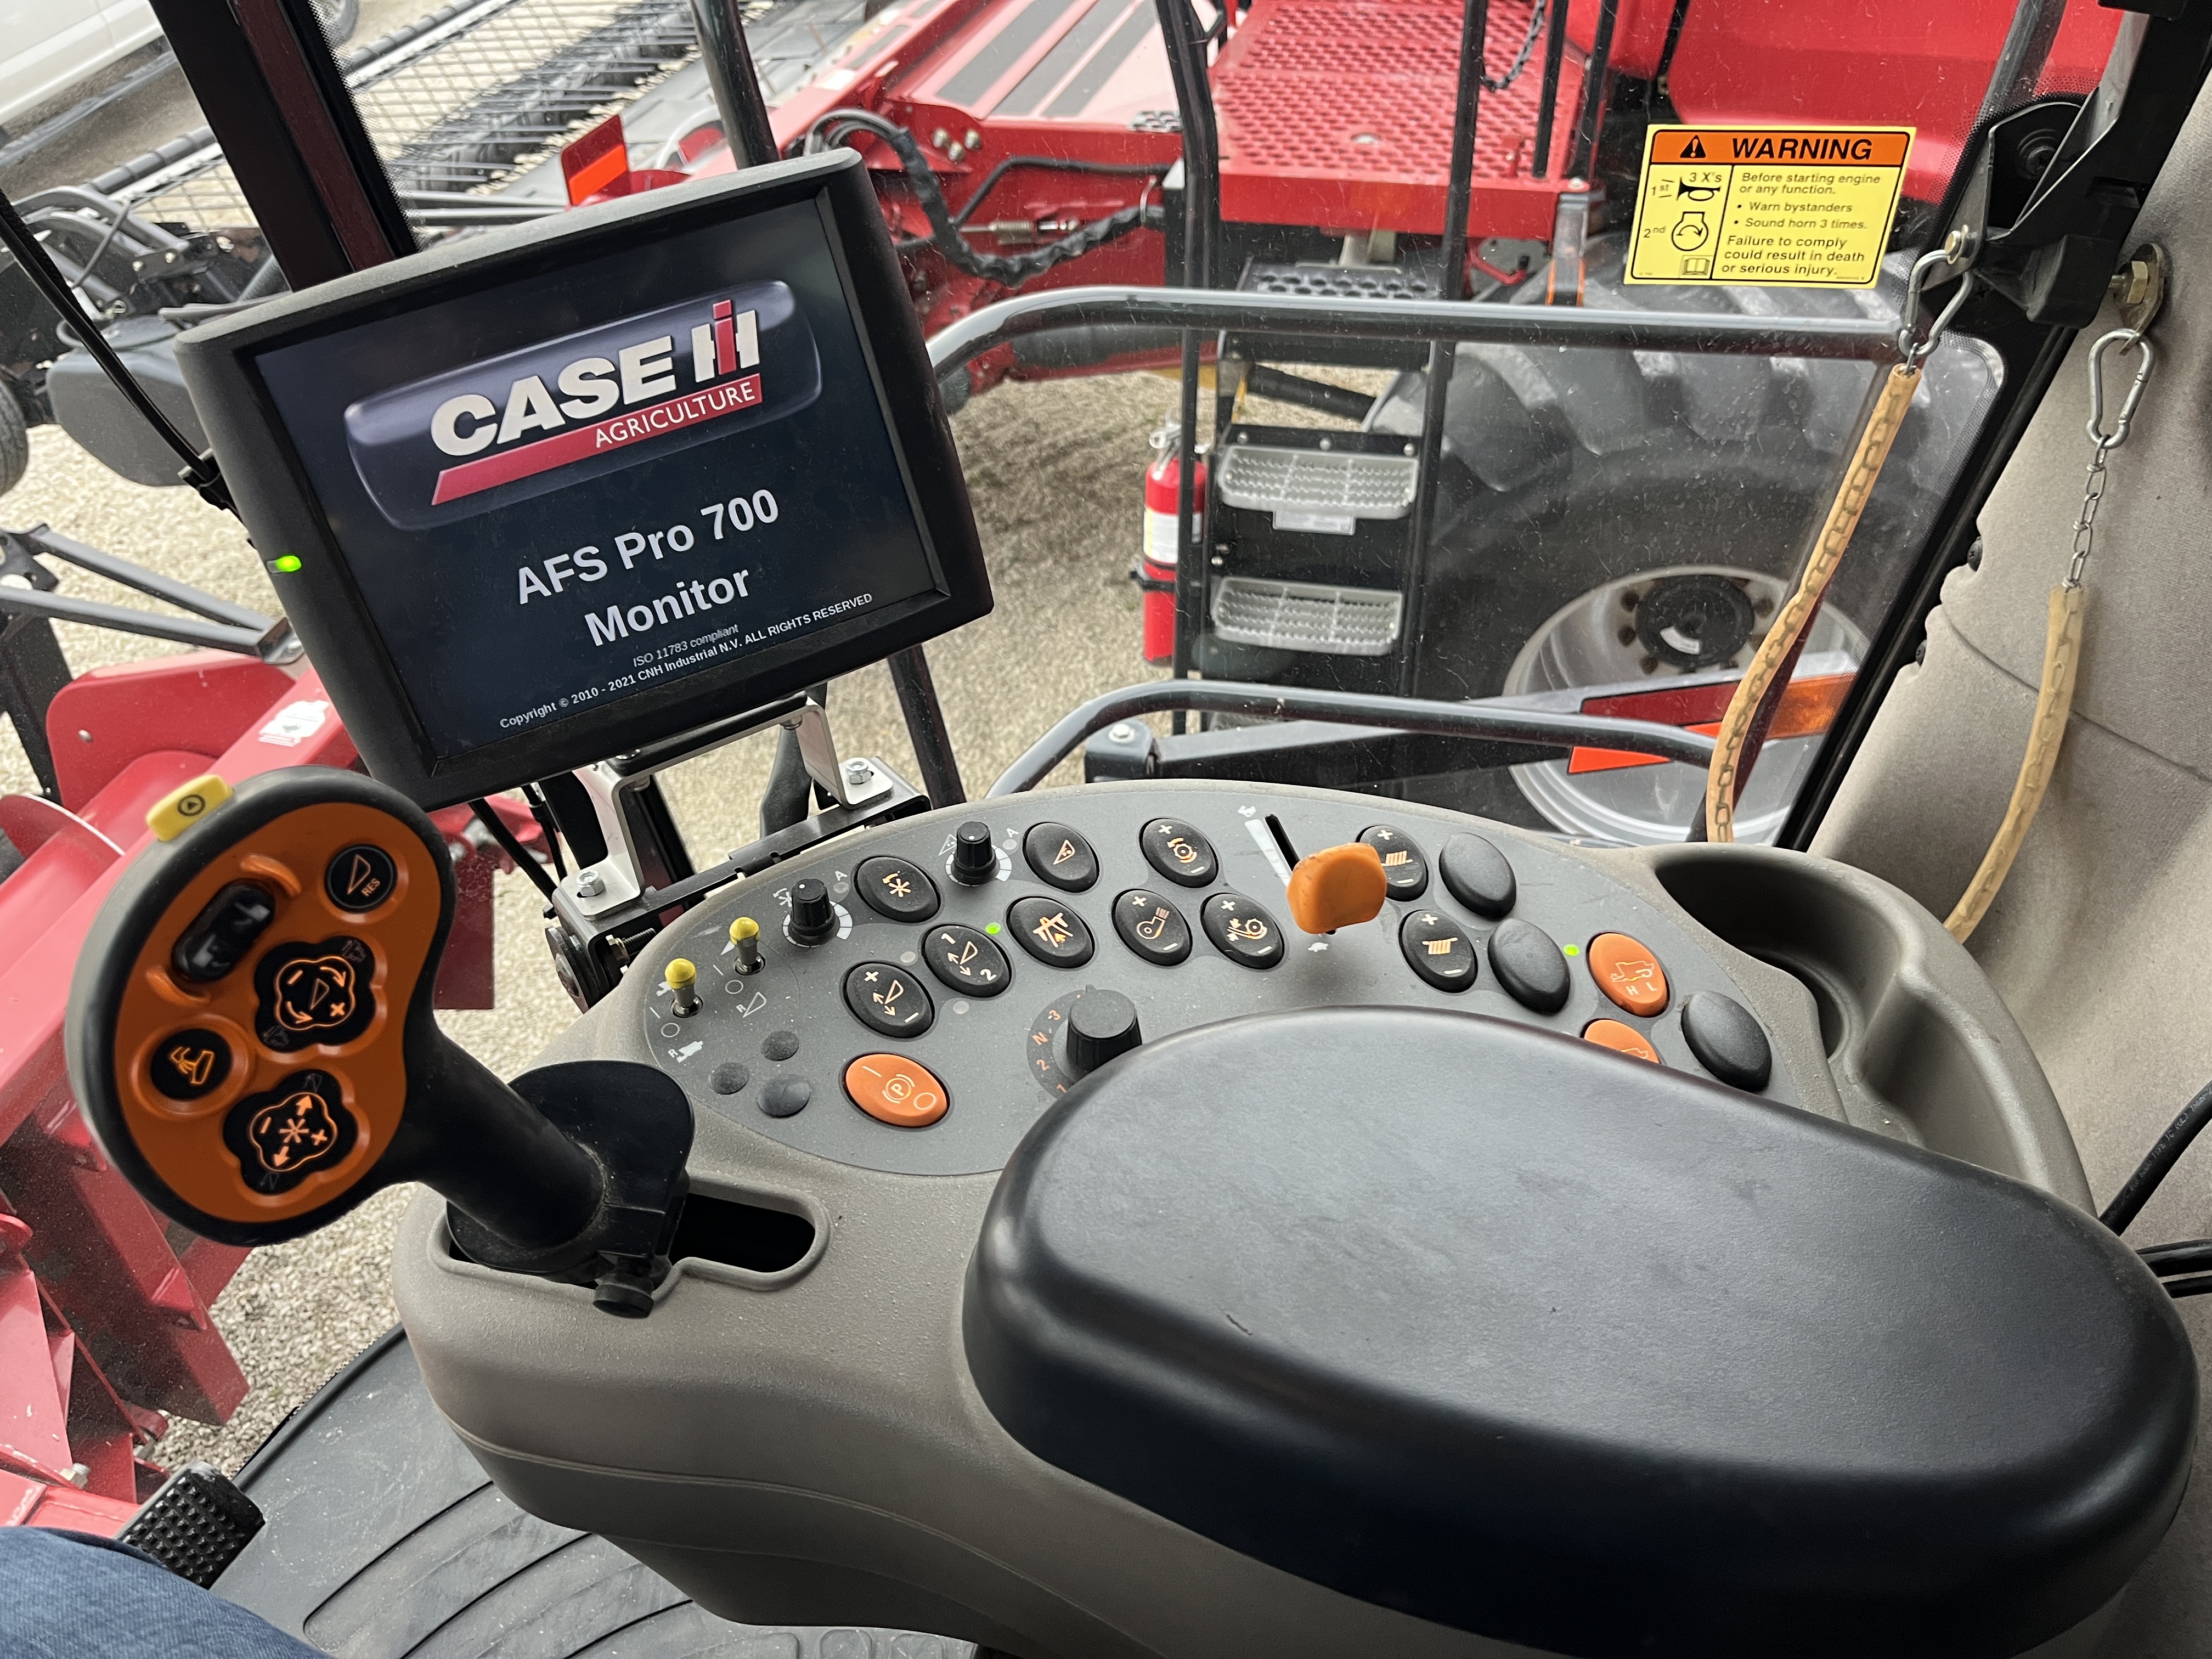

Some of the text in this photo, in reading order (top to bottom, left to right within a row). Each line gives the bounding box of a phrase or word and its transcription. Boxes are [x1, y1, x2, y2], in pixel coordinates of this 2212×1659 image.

[1733, 138, 1872, 160] WARNING
[1689, 172, 1722, 182] 3 X's
[1742, 172, 1881, 185] Before starting engine
[1756, 187, 1778, 196] any
[1782, 185, 1836, 194] function.
[1749, 201, 1853, 213] Warn bystanders
[1745, 218, 1867, 229] Sound horn 3 times.
[1727, 235, 1848, 250] Failure to comply
[1724, 250, 1865, 262] could result in death
[1722, 262, 1838, 277] or serious injury.
[430, 335, 677, 456] CASE
[595, 381, 755, 449] AGRICULTURE
[518, 489, 779, 605] AFS Pro 700
[585, 569, 749, 646] Monitor
[633, 624, 739, 667] ISO 11783 compliant
[500, 702, 557, 728] Copyright
[571, 687, 599, 704] 2010
[608, 675, 636, 692] 2021
[637, 665, 664, 681] CNH
[665, 647, 718, 672] Industrial
[719, 639, 742, 654] N.V.
[744, 630, 767, 645] ALL
[768, 614, 811, 637] RIGHTS
[812, 593, 873, 621] RESERVED
[1007, 827, 1019, 838] A
[834, 870, 848, 881] A
[361, 878, 381, 896] RES
[981, 969, 996, 981] 2
[1626, 982, 1658, 995] H L
[736, 1004, 746, 1013] R
[1048, 1009, 1062, 1020] 3
[668, 1049, 679, 1058] R
[1036, 1059, 1050, 1071] 2
